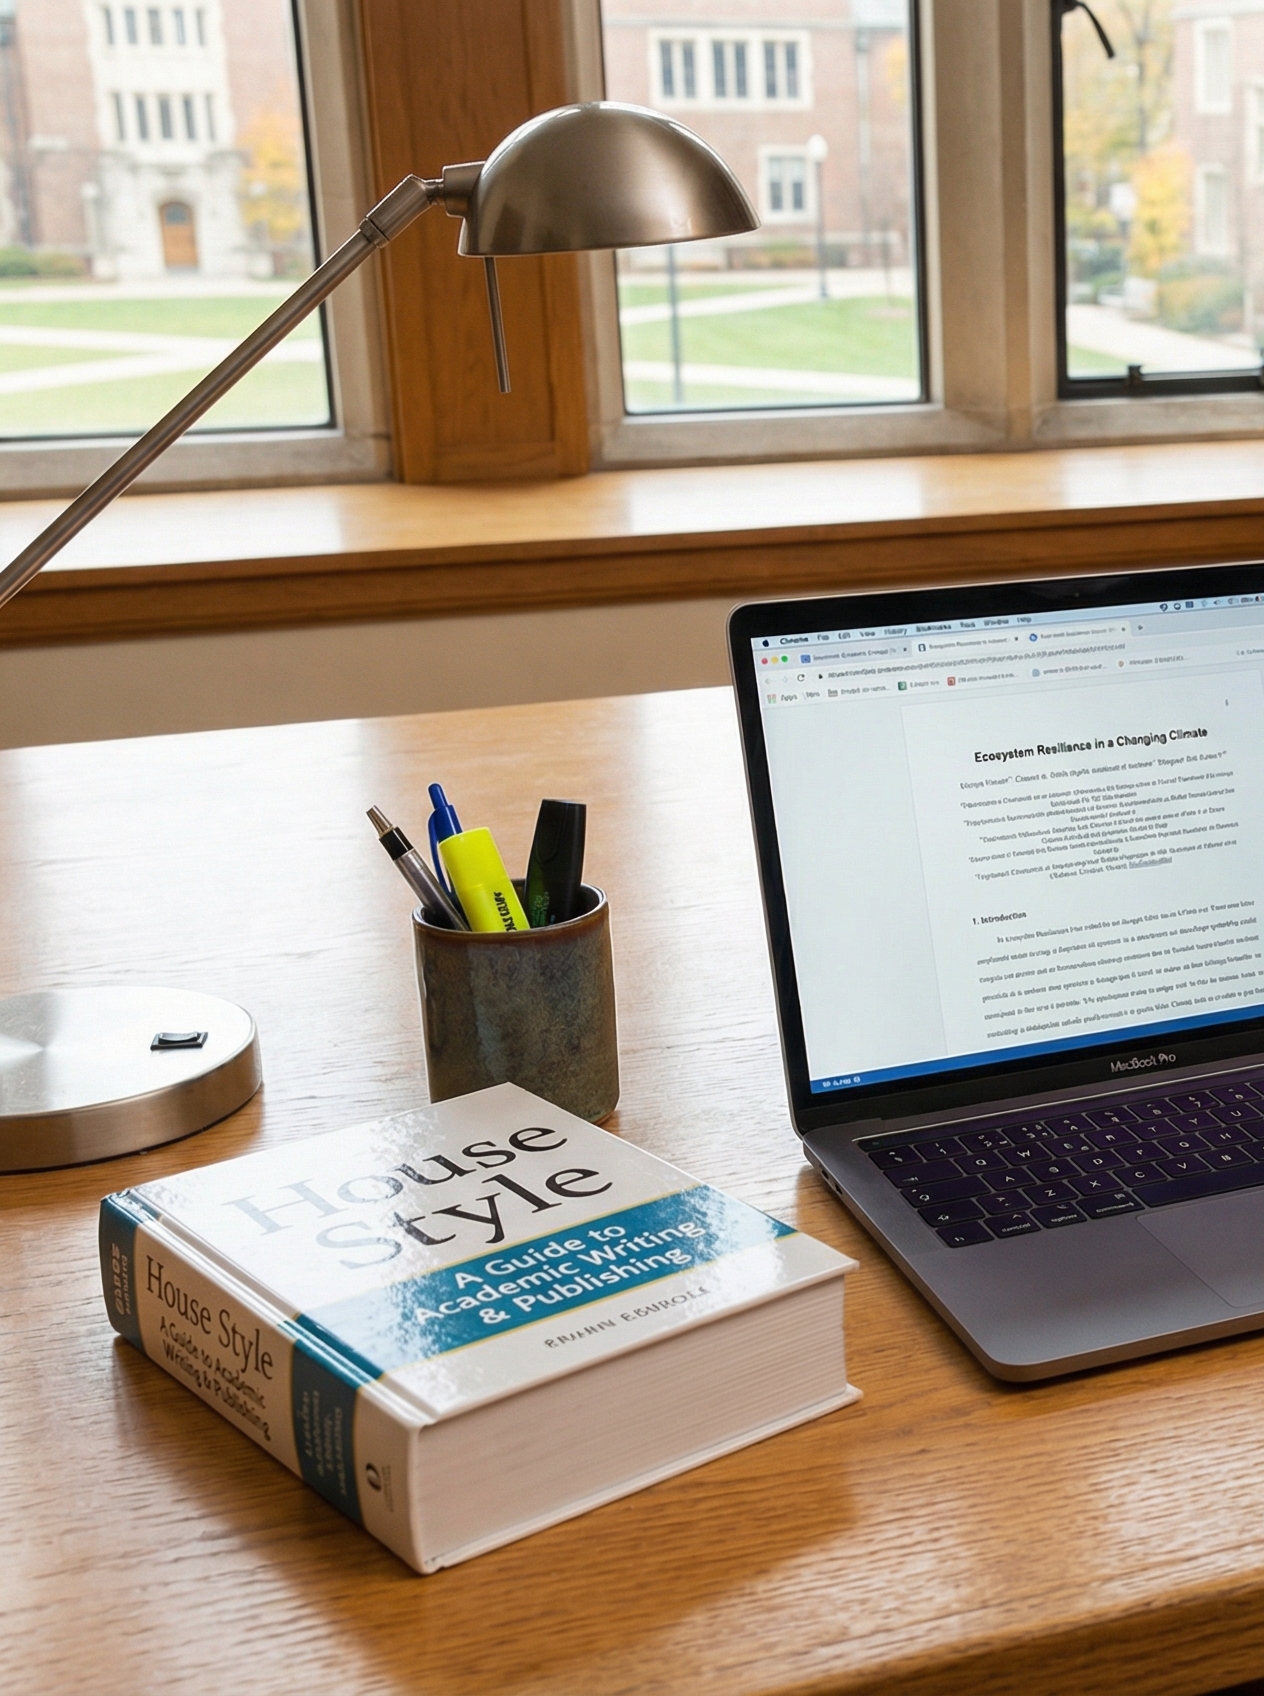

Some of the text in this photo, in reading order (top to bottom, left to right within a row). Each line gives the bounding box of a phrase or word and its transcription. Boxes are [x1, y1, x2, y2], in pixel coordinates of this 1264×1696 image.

[1095, 737, 1105, 750] in
[1107, 739, 1114, 749] a
[223, 1127, 568, 1236] House
[315, 1167, 613, 1270] Style
[414, 1220, 706, 1326] Academic Writing
[454, 1224, 627, 1290] A Guide to
[479, 1246, 694, 1326] & Publishing
[146, 1254, 212, 1335] House
[218, 1308, 274, 1381] Style
